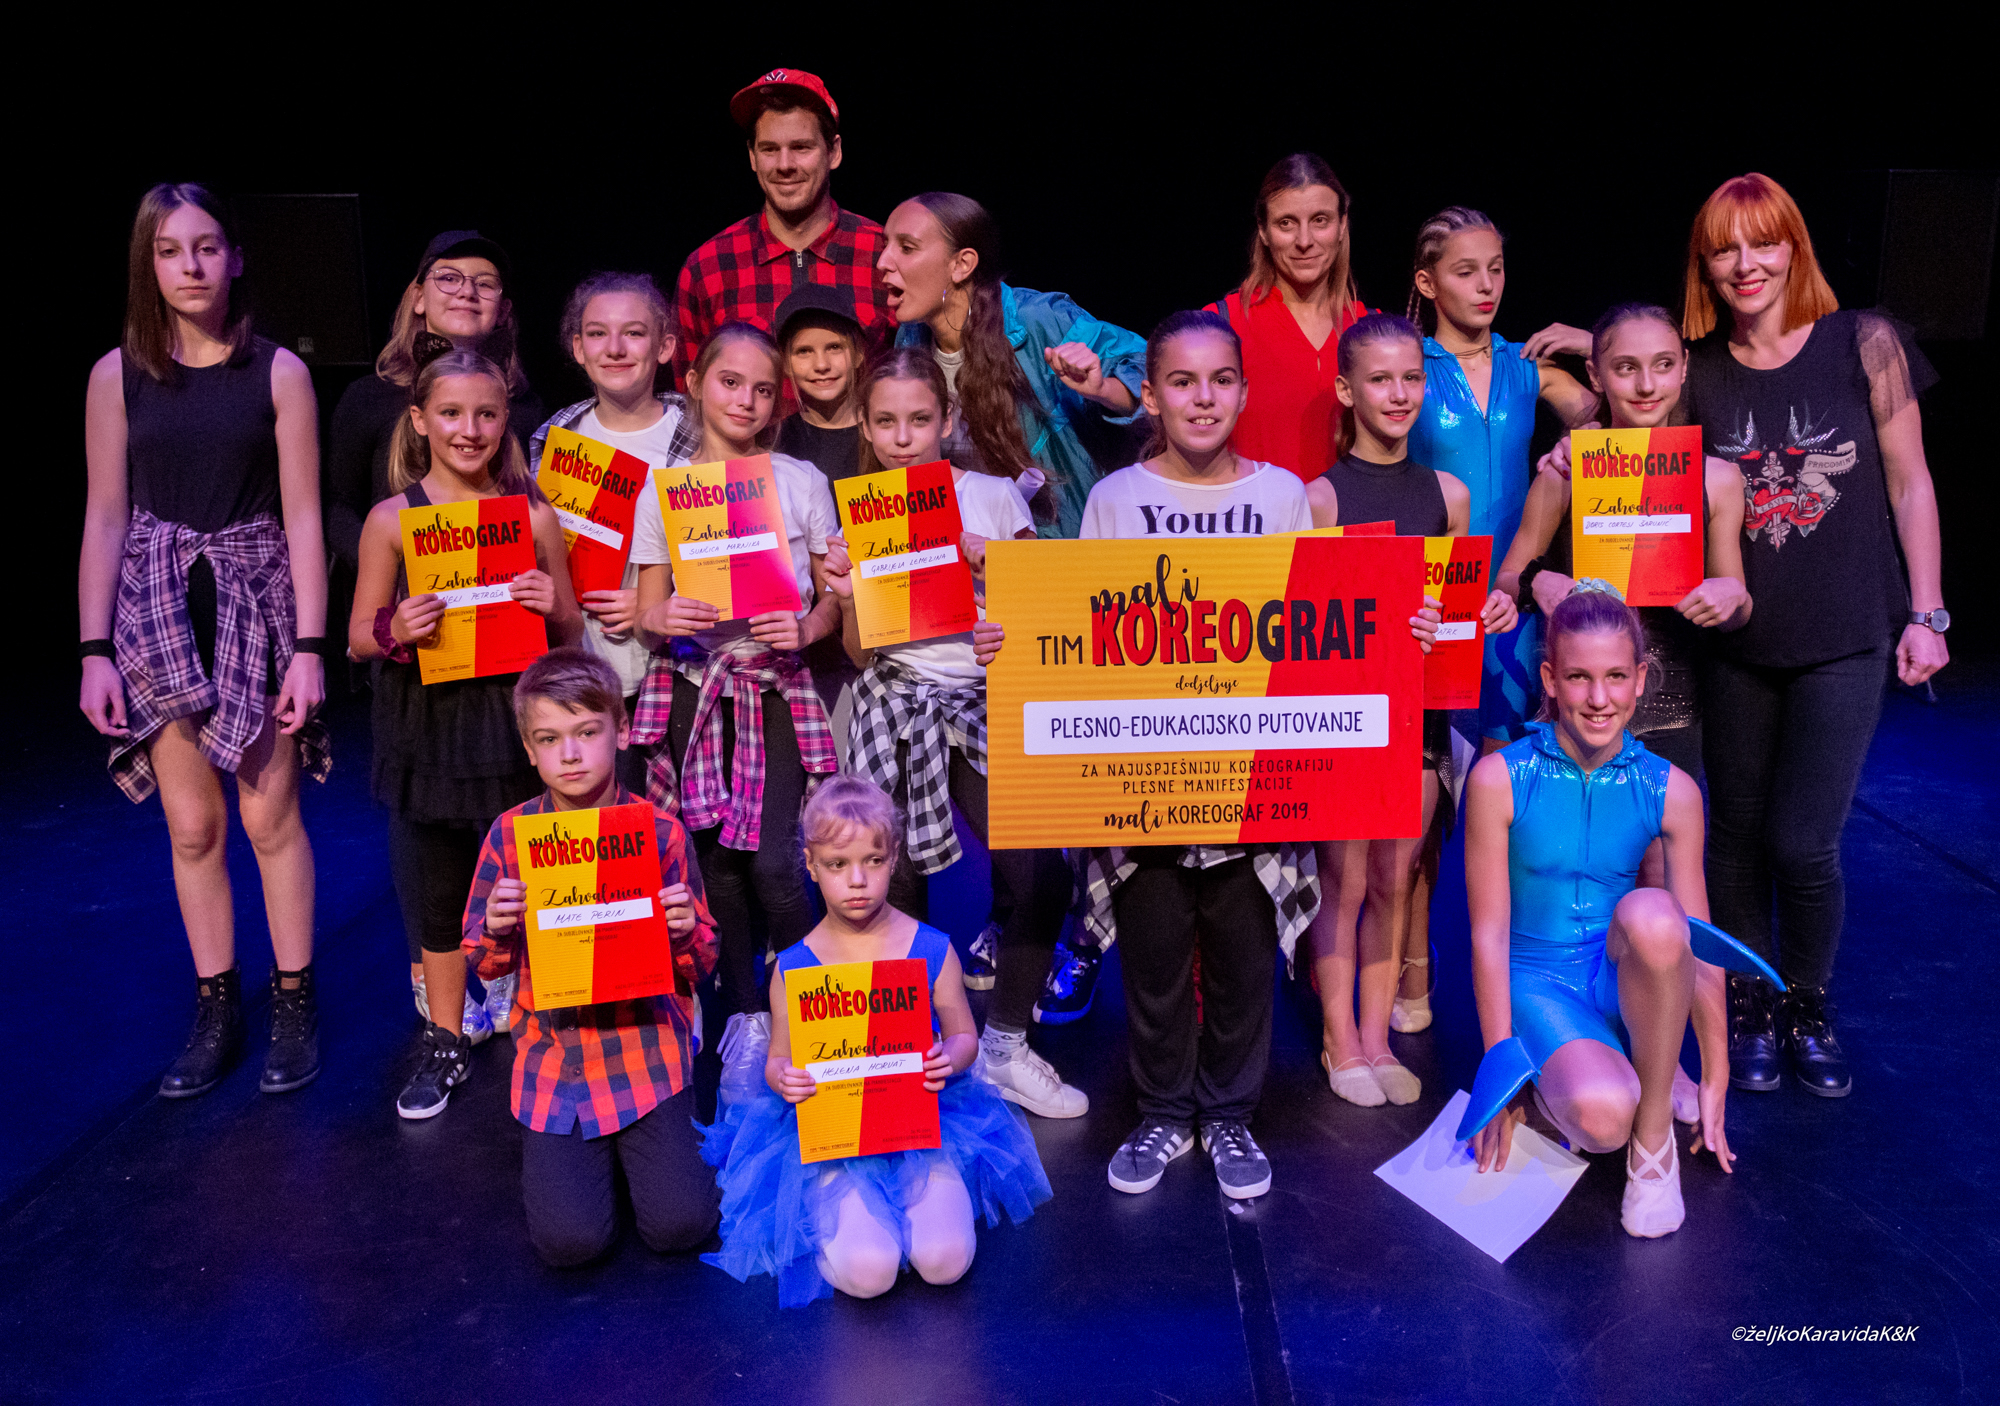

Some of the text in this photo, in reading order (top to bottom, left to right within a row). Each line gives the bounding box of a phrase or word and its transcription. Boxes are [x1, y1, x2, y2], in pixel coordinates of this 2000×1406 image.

[553, 442, 590, 464] mali
[1581, 437, 1622, 460] mali
[550, 450, 637, 500] KOREOGRAF
[1582, 451, 1691, 479] KOREOGRAF
[665, 473, 703, 495] mali
[667, 477, 767, 511] KOREOGRAF
[848, 482, 884, 508] mali
[849, 485, 947, 526] KOREOGRAF
[1136, 504, 1264, 535] Youth
[412, 513, 452, 538] mali
[413, 520, 522, 556] KOREOGRAF
[1090, 553, 1199, 617] mali
[1424, 560, 1482, 585] EOGRAF
[1037, 598, 1376, 667] TIM KOREOGRAF
[1175, 674, 1239, 694] dodjeljuje
[1051, 711, 1363, 739] PLESNO-EDUKACIJSKO PUTOVANJE
[1081, 758, 1334, 778] ZA NAJUSPJEŠNIJU KOREOGRAFIJU
[1123, 777, 1293, 794] PLESNE MANIFESTACIJE
[1104, 799, 1163, 834] mali
[1168, 803, 1264, 824] KOREOGRAF
[527, 821, 571, 848] mali
[529, 831, 646, 869] KOREOGRAF
[554, 909, 625, 925] MATE PERIN
[798, 974, 843, 1002] mali
[800, 986, 918, 1022] KOREOGRAF
[822, 1060, 906, 1078] HELENA HORVAT
